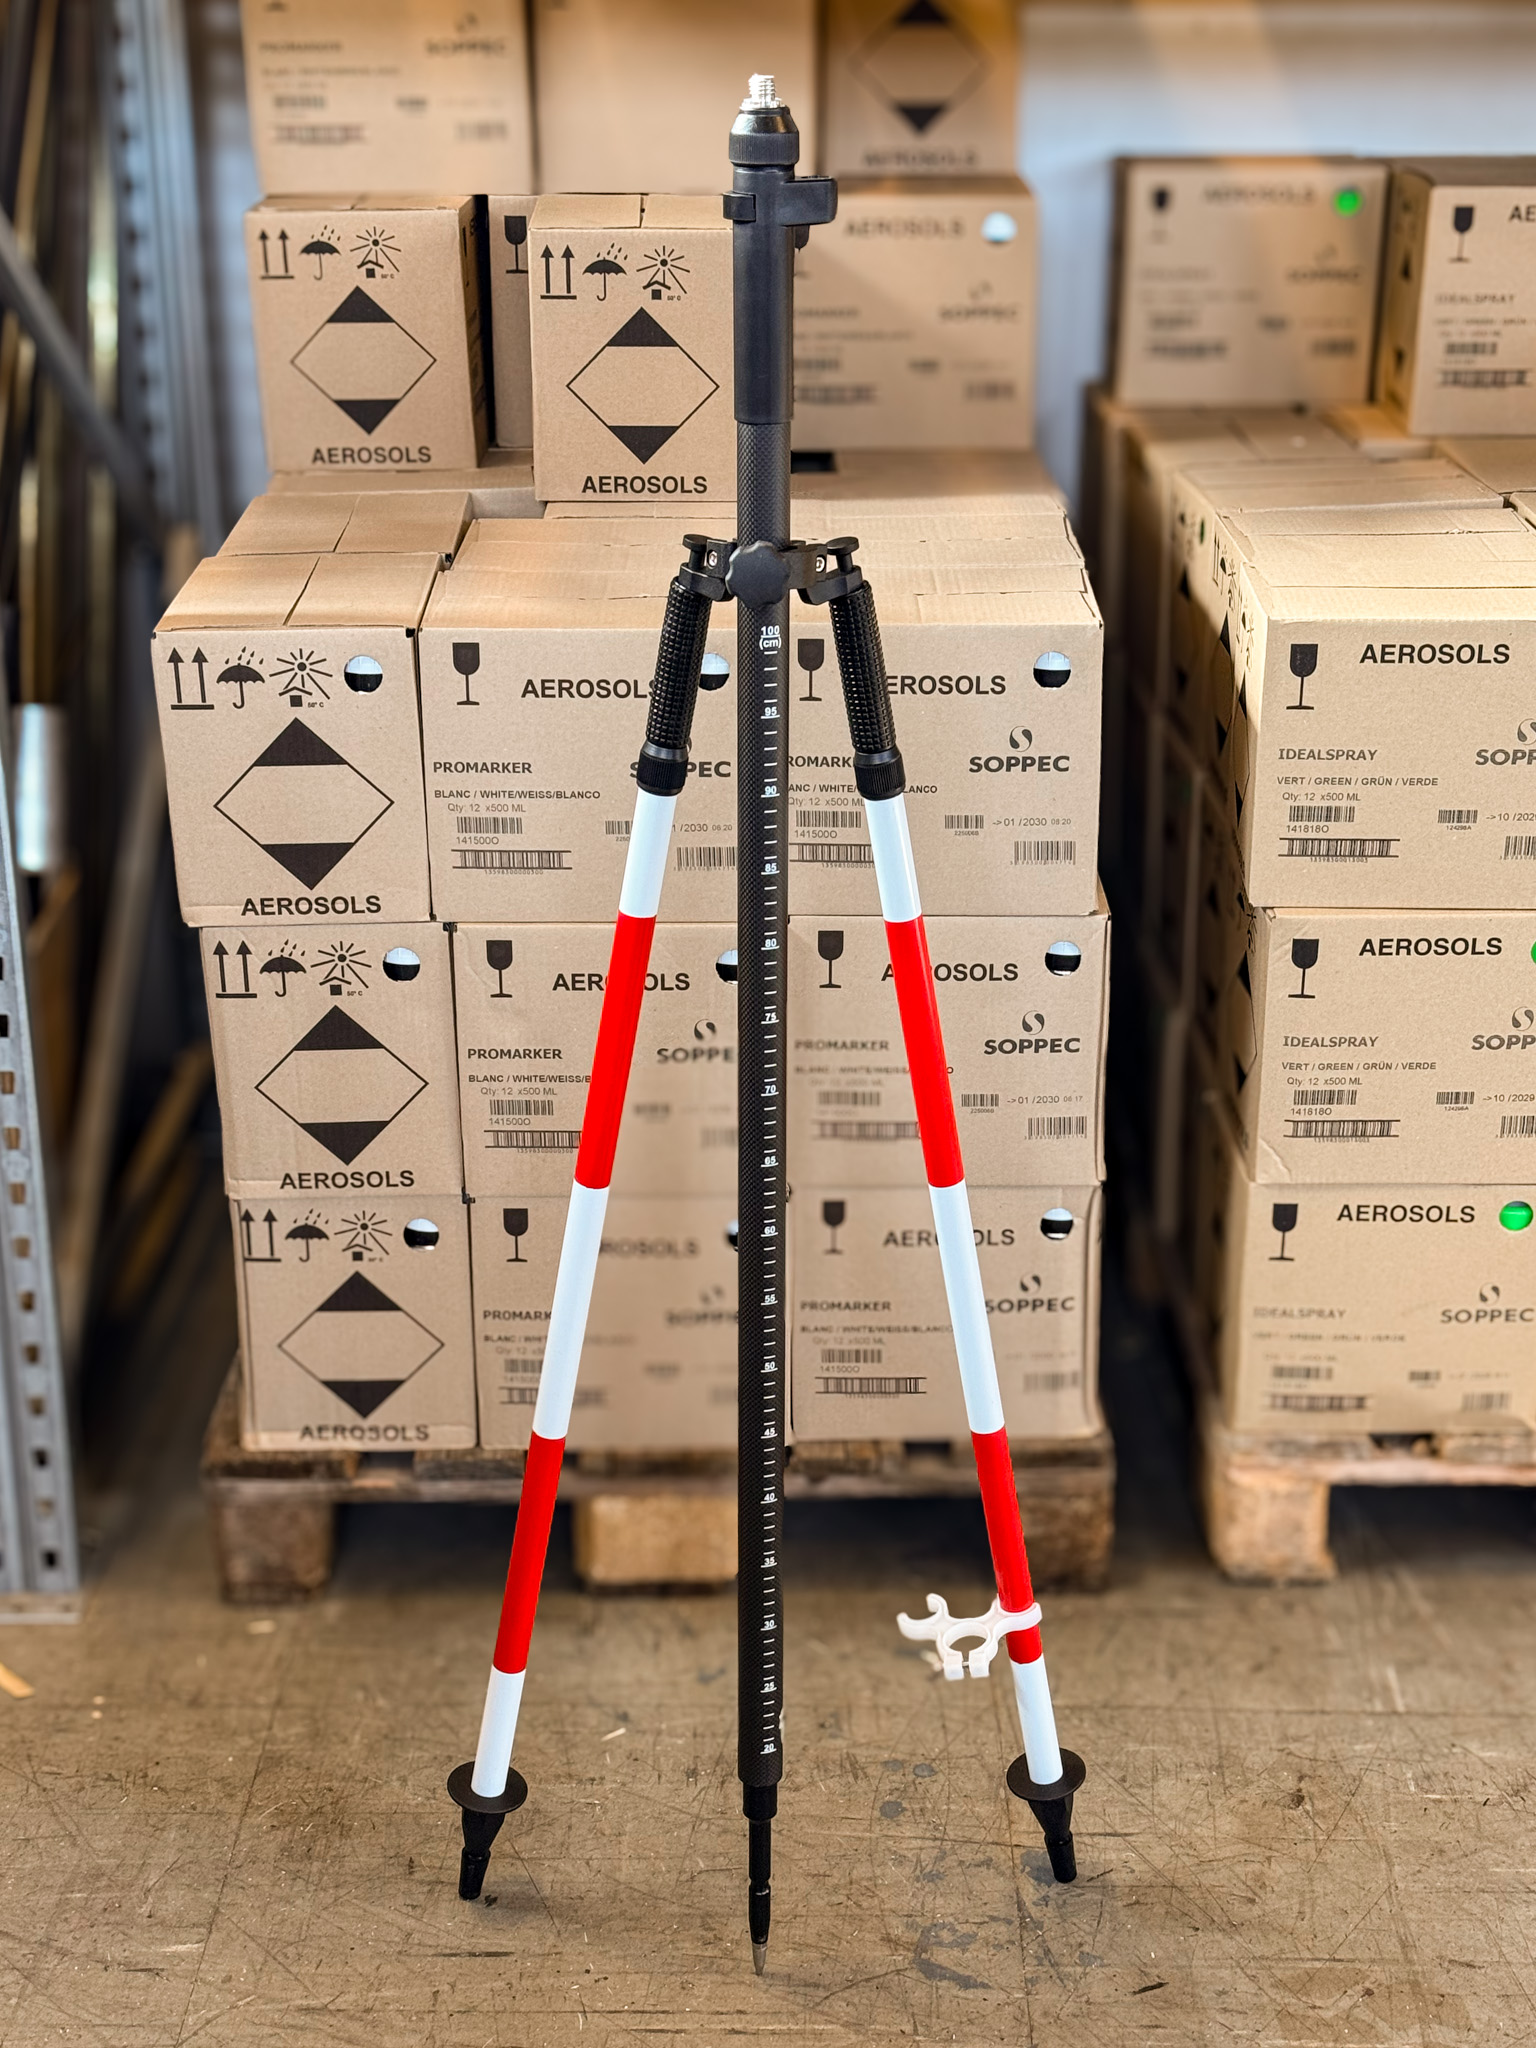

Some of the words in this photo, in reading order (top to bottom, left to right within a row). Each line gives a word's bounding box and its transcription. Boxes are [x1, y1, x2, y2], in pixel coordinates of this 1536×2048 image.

[312, 446, 432, 464] AEROSOLS
[581, 476, 708, 494] AEROSOLS
[761, 626, 780, 636] 100
[759, 637, 782, 650] (cm)
[1359, 643, 1510, 663] AEROSOLS
[887, 675, 1006, 695] EROSOLS
[765, 707, 777, 716] 95
[1278, 748, 1378, 761] IDEALSPRAY
[433, 762, 532, 774] PROMARKER
[629, 761, 731, 778] SPEC
[969, 756, 1070, 773] SOPPEC
[1277, 776, 1305, 785] VERT
[1314, 777, 1352, 786] GREEN
[1361, 775, 1392, 786] GRÜN
[1401, 777, 1439, 786] VERDE
[434, 790, 471, 798] BLANC
[480, 791, 600, 799] WHITE/WEISS/BLANCO
[765, 786, 777, 795] 90
[809, 798, 820, 806] 12
[825, 798, 849, 806] x500
[1304, 793, 1315, 801] 12
[1320, 793, 1344, 801] x500
[1346, 793, 1361, 801] ML
[469, 804, 480, 812] 12
[485, 804, 509, 812] x500
[511, 804, 526, 812] ML
[1513, 813, 1536, 821] /202
[765, 863, 777, 872] 85
[241, 896, 382, 916] AEROSOLS
[765, 939, 777, 948] 80
[1358, 937, 1503, 956] AEROSOLS
[881, 963, 1018, 982] AOSOLS
[552, 973, 690, 991] AEROLS
[765, 1013, 777, 1021] 75
[984, 1038, 1080, 1055] SOPPEC
[1282, 1036, 1379, 1048] IDEALSPRAY
[467, 1048, 563, 1060] PROMARKER
[1282, 1062, 1309, 1071] VERT
[1318, 1063, 1353, 1071] GREEN
[1363, 1061, 1392, 1071] GRÜN
[1401, 1062, 1437, 1070] VERDE
[468, 1074, 504, 1083] BLANC
[1308, 1078, 1319, 1086] 12
[1323, 1078, 1346, 1086] x500
[1348, 1078, 1363, 1086] ML
[502, 1087, 513, 1095] 12
[517, 1087, 541, 1096] x500
[542, 1087, 558, 1096] ML
[765, 1085, 777, 1094] 70
[280, 1170, 415, 1190] AEROSOLS
[1337, 1204, 1475, 1223] AEROSOLS
[764, 1226, 776, 1234] 60
[884, 1229, 1015, 1247] AEROLS
[764, 1294, 775, 1303] 55
[801, 1301, 891, 1311] PROMARKER
[985, 1297, 1075, 1313] SOPPEC
[1440, 1308, 1535, 1324] SOPPEC
[764, 1362, 775, 1370] 50
[300, 1425, 430, 1442] AEROSOLS
[764, 1428, 775, 1436] 45
[764, 1493, 775, 1501] 40
[764, 1557, 775, 1565] 35
[764, 1620, 774, 1628] 30
[764, 1682, 774, 1690] 25
